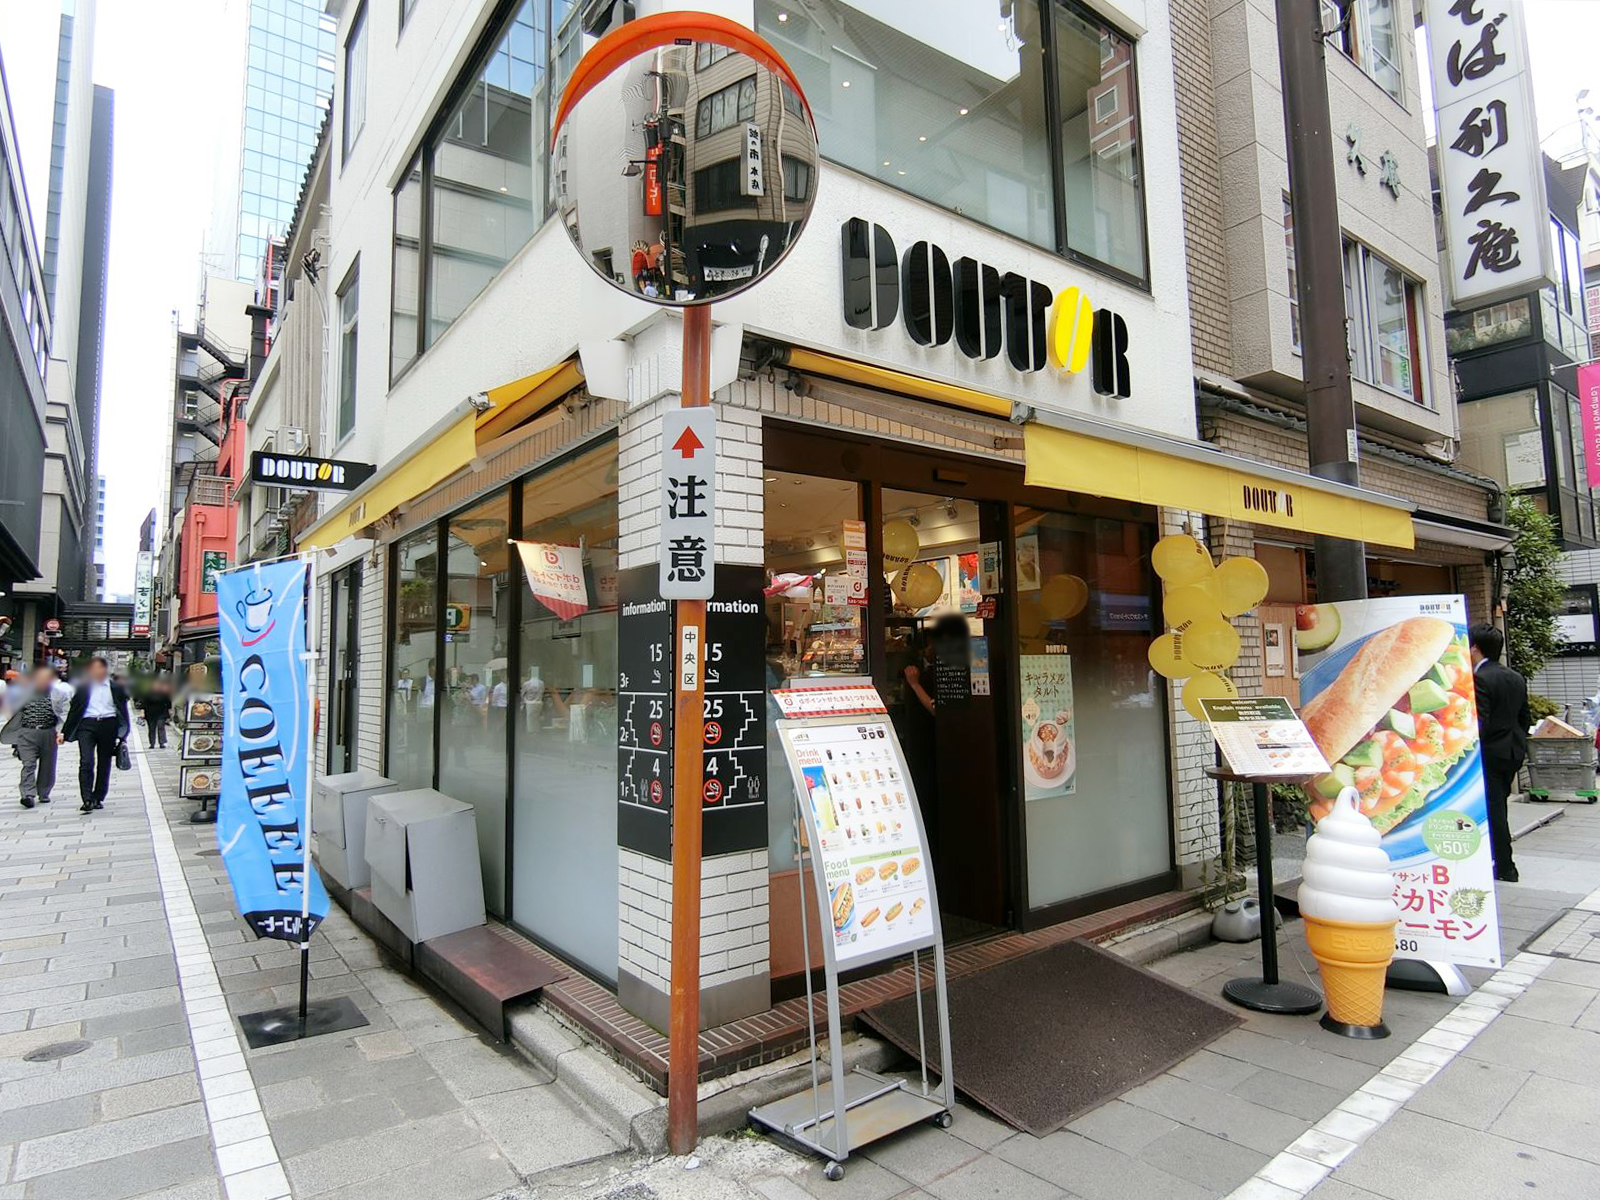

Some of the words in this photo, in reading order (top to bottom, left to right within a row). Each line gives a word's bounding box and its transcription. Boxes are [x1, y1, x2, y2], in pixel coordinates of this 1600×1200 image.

[841, 216, 1131, 400] DOUTOR
[262, 457, 346, 484] DOUTOR
[1243, 485, 1294, 518] DOUTOR
[667, 475, 708, 583] 注意
[623, 599, 667, 617] information
[706, 601, 759, 615] rmation
[650, 643, 663, 662] 15
[684, 631, 697, 685] 中央区
[650, 700, 663, 719] 25
[620, 726, 630, 743] 2F
[796, 748, 821, 758] Drink
[798, 755, 823, 765] menu
[652, 757, 661, 777] 4
[706, 757, 720, 777] 4
[824, 858, 848, 871] Food
[826, 869, 851, 880] menu
[1392, 871, 1430, 884] サンド
[1400, 918, 1487, 942] ーモン
[1395, 938, 1418, 953] 80
